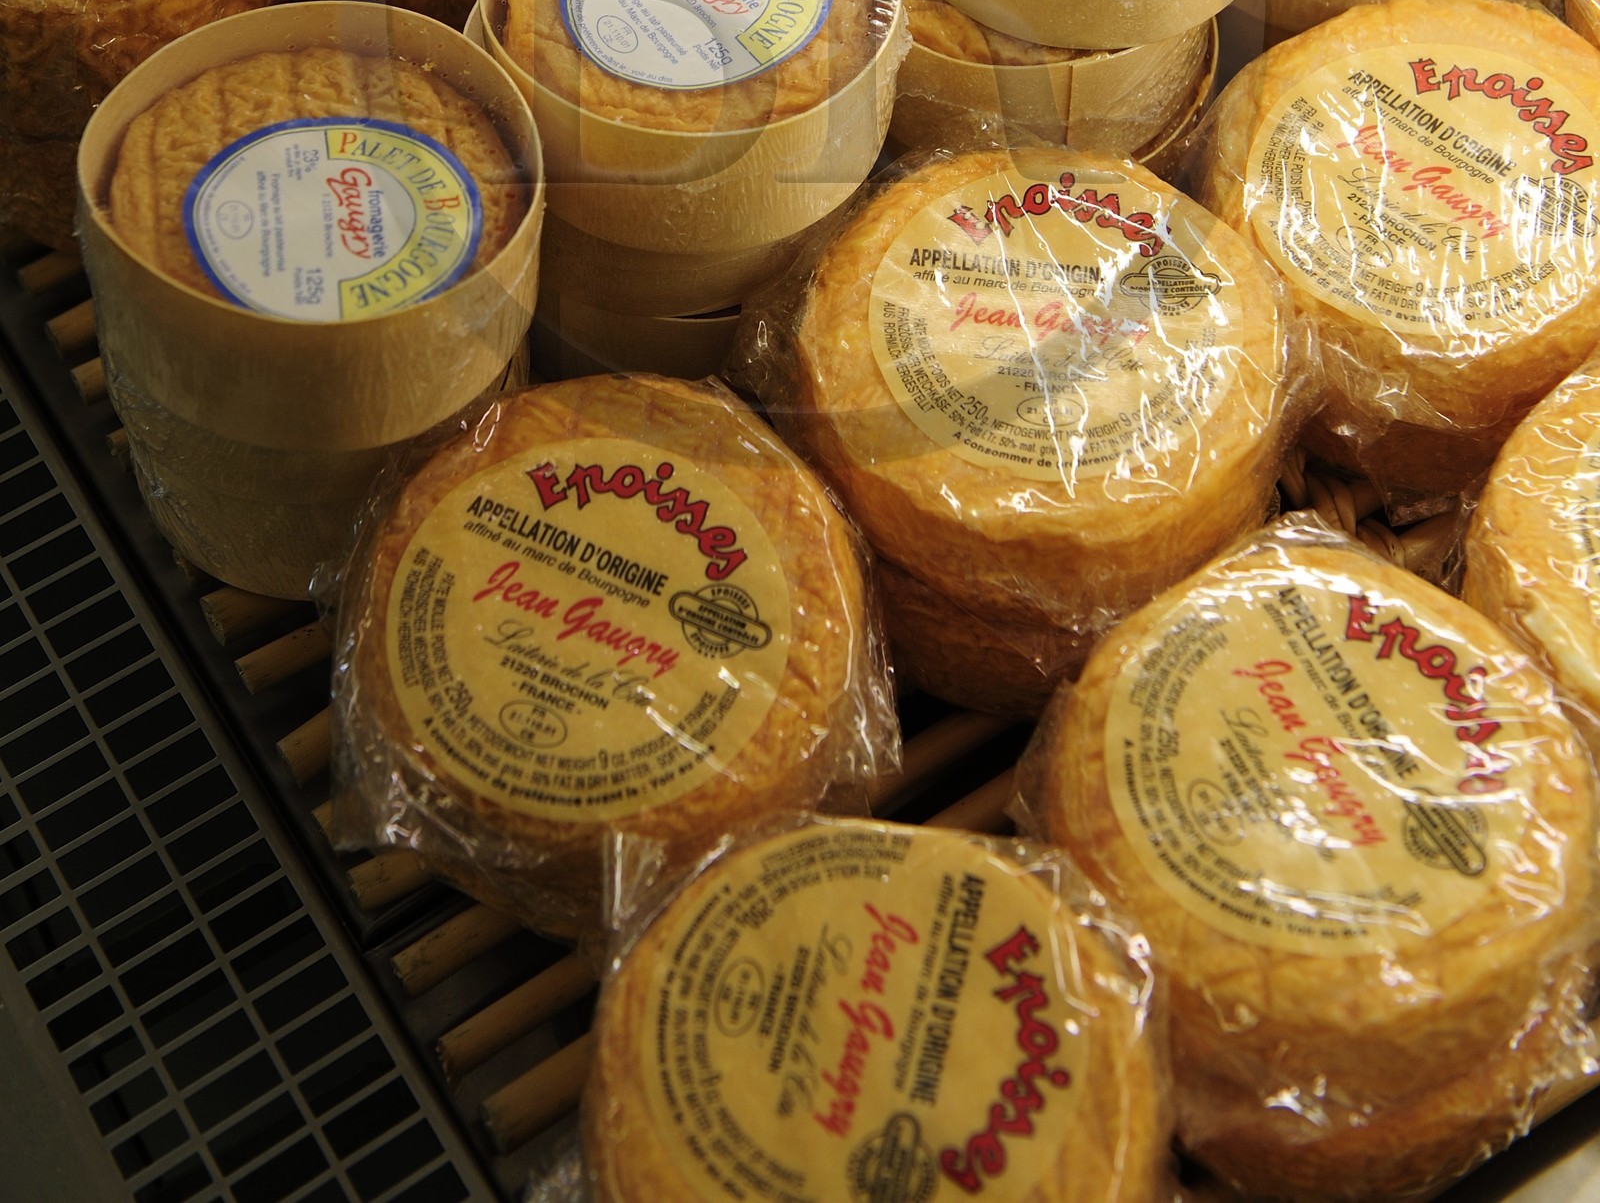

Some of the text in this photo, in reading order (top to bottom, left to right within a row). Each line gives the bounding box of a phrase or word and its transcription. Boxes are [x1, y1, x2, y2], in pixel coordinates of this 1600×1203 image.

[647, 31, 679, 66] Bourgogne
[655, 25, 689, 57] pasteurisé
[704, 36, 734, 67] 125g
[1347, 68, 1515, 178] APPELLATION D'ORIGINE
[1388, 114, 1419, 139] marc
[1432, 143, 1496, 185] Bourgogne
[1408, 58, 1595, 176] Epoisses
[326, 167, 372, 261] Gaugry
[340, 131, 463, 309] PALET DE BOURGOGNE
[366, 189, 386, 259] fromagerie
[1380, 210, 1438, 253] BROCHON
[1402, 165, 1512, 241] Gaugry
[909, 248, 1022, 276] APPELLATION
[952, 273, 972, 285] au
[974, 276, 1011, 289] marc
[949, 290, 1026, 335] Jean
[884, 322, 901, 362] ROHMILCH
[894, 358, 937, 415] HERGESTELLT
[930, 363, 951, 389] POIDS
[962, 438, 1034, 466] consommer
[466, 495, 670, 597] APPELLATION D'ORIGINE
[525, 461, 749, 582] Epoisses
[463, 519, 652, 610] affiné au marc de Bourgogne
[472, 559, 682, 680] Jean Gaugry
[1277, 586, 1356, 700] APPELLATION
[499, 655, 610, 711] 21220 BROCHON
[518, 681, 576, 714] FRANCE
[1232, 659, 1306, 734] Jean
[813, 901, 921, 1139] Jean Gaugry
[908, 871, 987, 1109] APPELLATION D'ORIGINE
[940, 923, 1072, 1195] Epoisses
